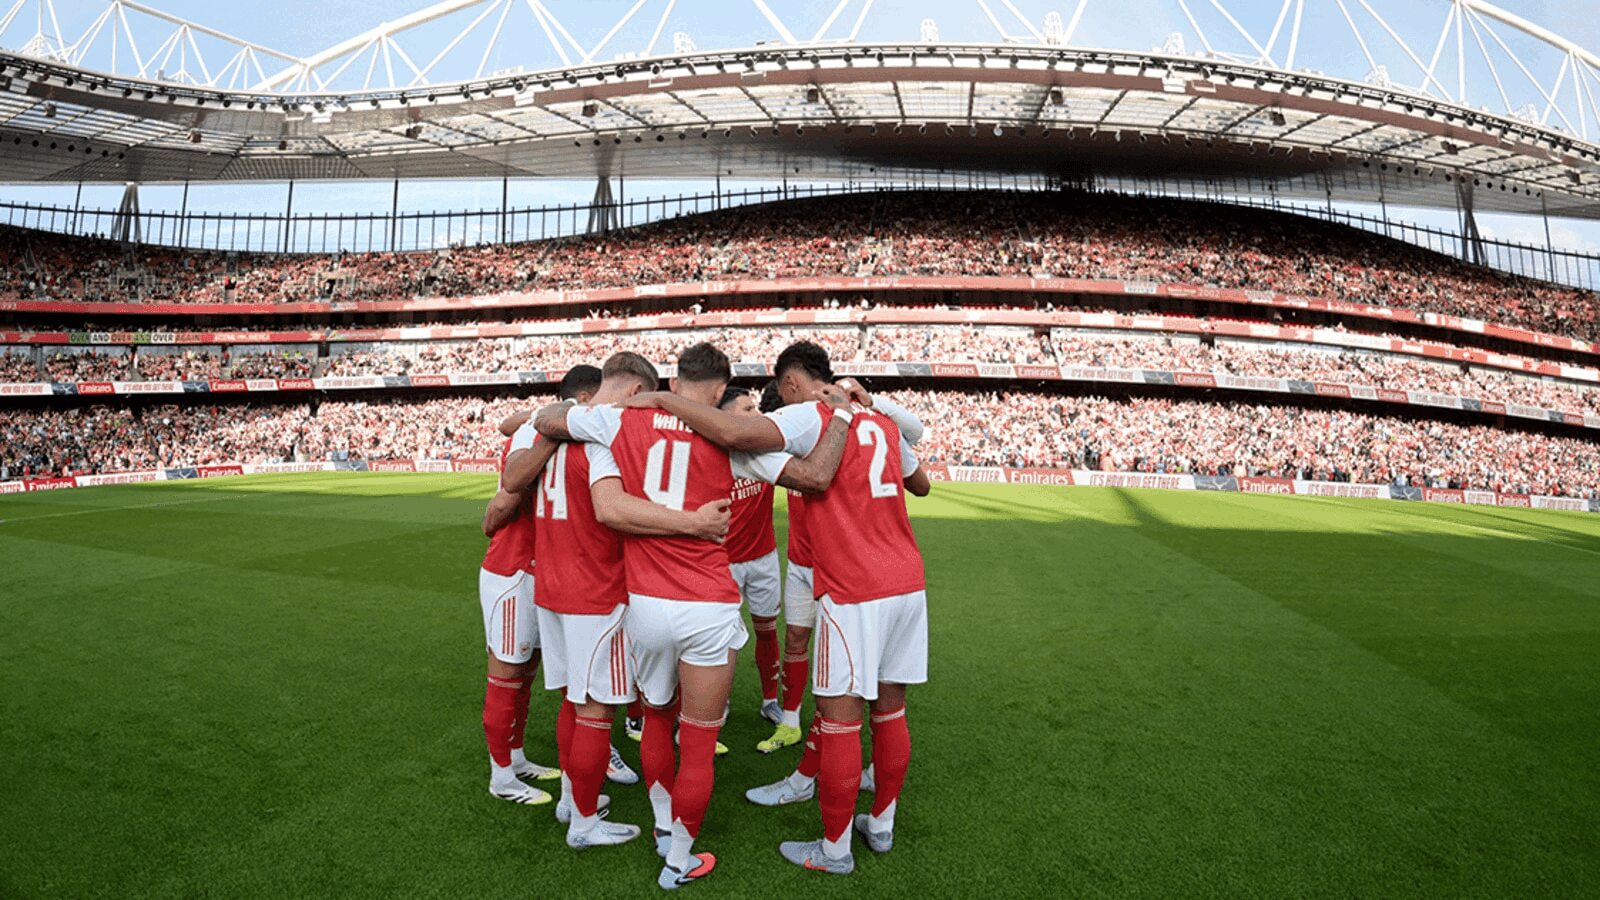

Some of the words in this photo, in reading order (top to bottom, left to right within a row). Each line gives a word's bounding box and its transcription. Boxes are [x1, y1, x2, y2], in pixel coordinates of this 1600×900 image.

[152, 333, 174, 342] OVER
[936, 366, 975, 376] Emirates
[1020, 368, 1057, 378] Emirates
[856, 420, 898, 498] 2
[643, 438, 692, 512] 4
[955, 468, 969, 481] FLY
[970, 468, 1000, 482] BETTER
[1011, 470, 1068, 484] Emirates
[1090, 474, 1104, 487] IT'S
[1104, 474, 1124, 487] HOW
[1126, 475, 1141, 488] YOU
[1142, 475, 1158, 489] GET
[1157, 476, 1181, 489] THERE
[29, 480, 74, 491] Emirates
[737, 482, 762, 500] BETTER
[1243, 480, 1290, 493] Emirates
